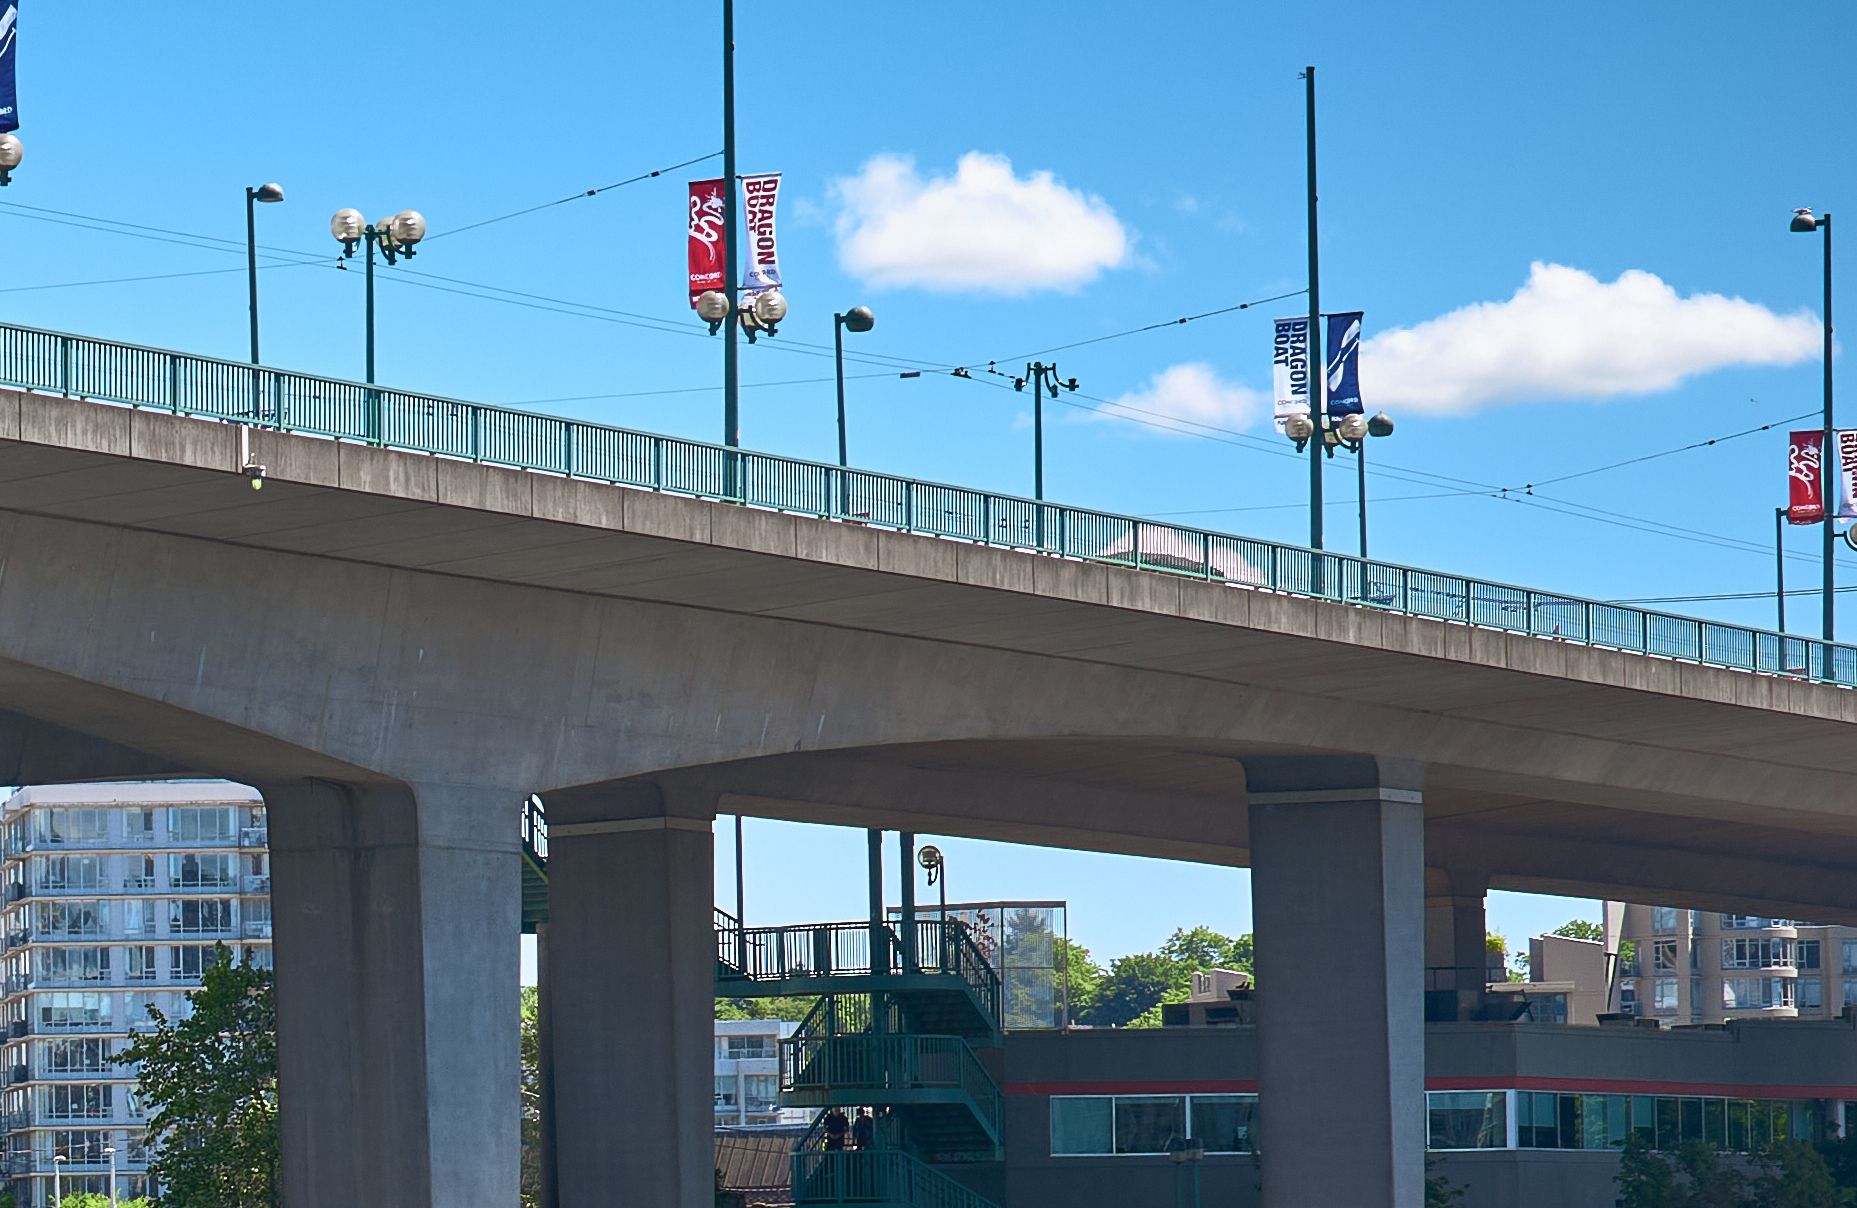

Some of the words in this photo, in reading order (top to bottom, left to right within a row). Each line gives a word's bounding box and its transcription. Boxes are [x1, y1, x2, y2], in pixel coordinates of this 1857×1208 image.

[745, 181, 761, 233] BOAT
[757, 178, 778, 265] DRAGON
[1274, 322, 1291, 366] BOAT
[1290, 321, 1308, 395] DRAGON
